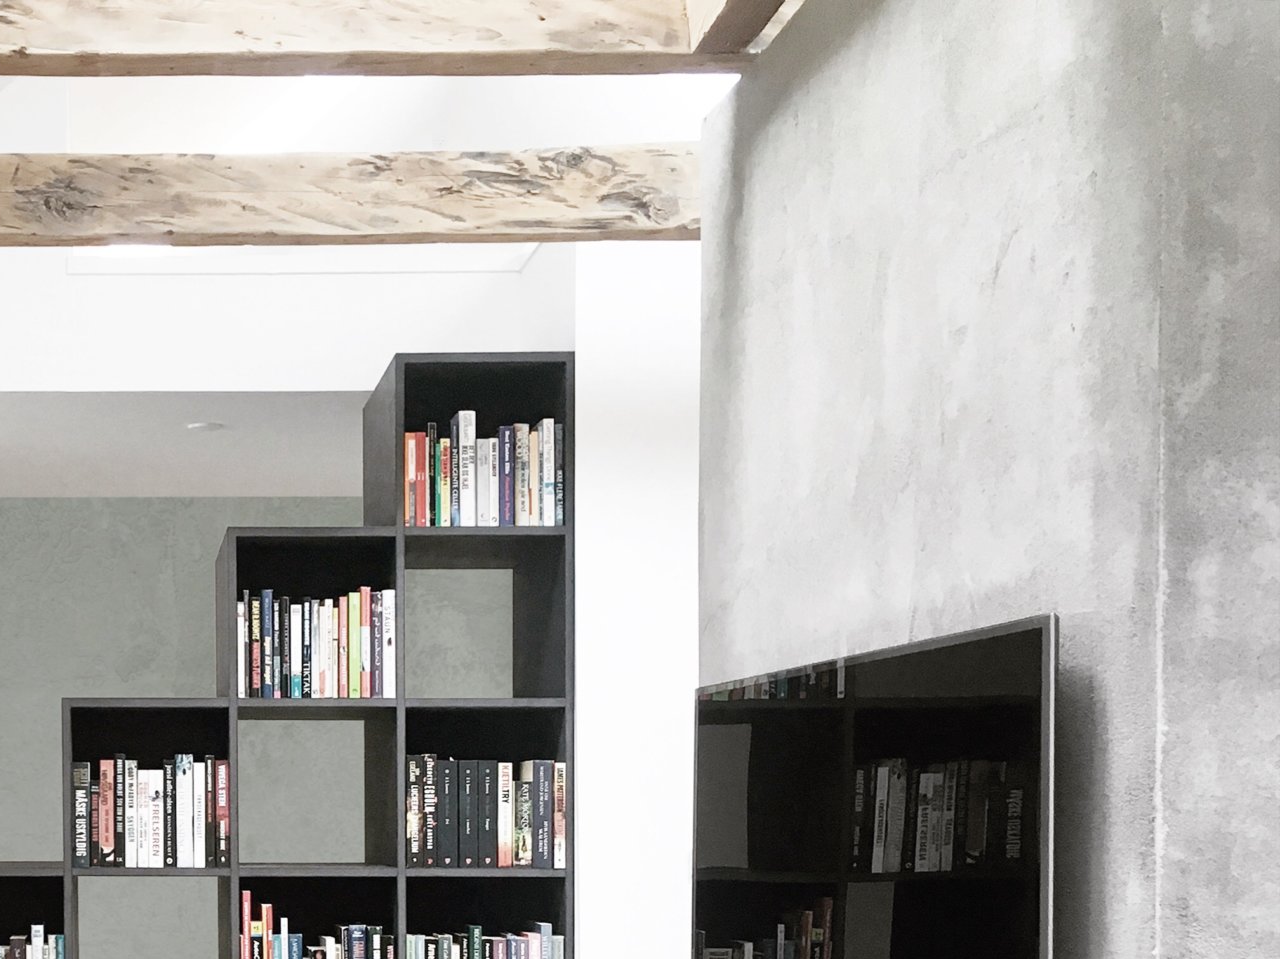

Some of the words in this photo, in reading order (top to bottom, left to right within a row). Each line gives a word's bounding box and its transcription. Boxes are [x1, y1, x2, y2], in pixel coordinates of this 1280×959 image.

[165, 765, 173, 779] jussi
[501, 765, 509, 789] KJETIL
[75, 790, 87, 816] MÅSKE
[410, 785, 418, 814] LUCIFERS
[424, 786, 435, 813] EGHOLM
[501, 789, 509, 804] TRY
[521, 784, 529, 800] KATE
[521, 803, 529, 833] MORTON
[75, 818, 87, 856] USKYLDIG
[428, 944, 436, 959] Arne
